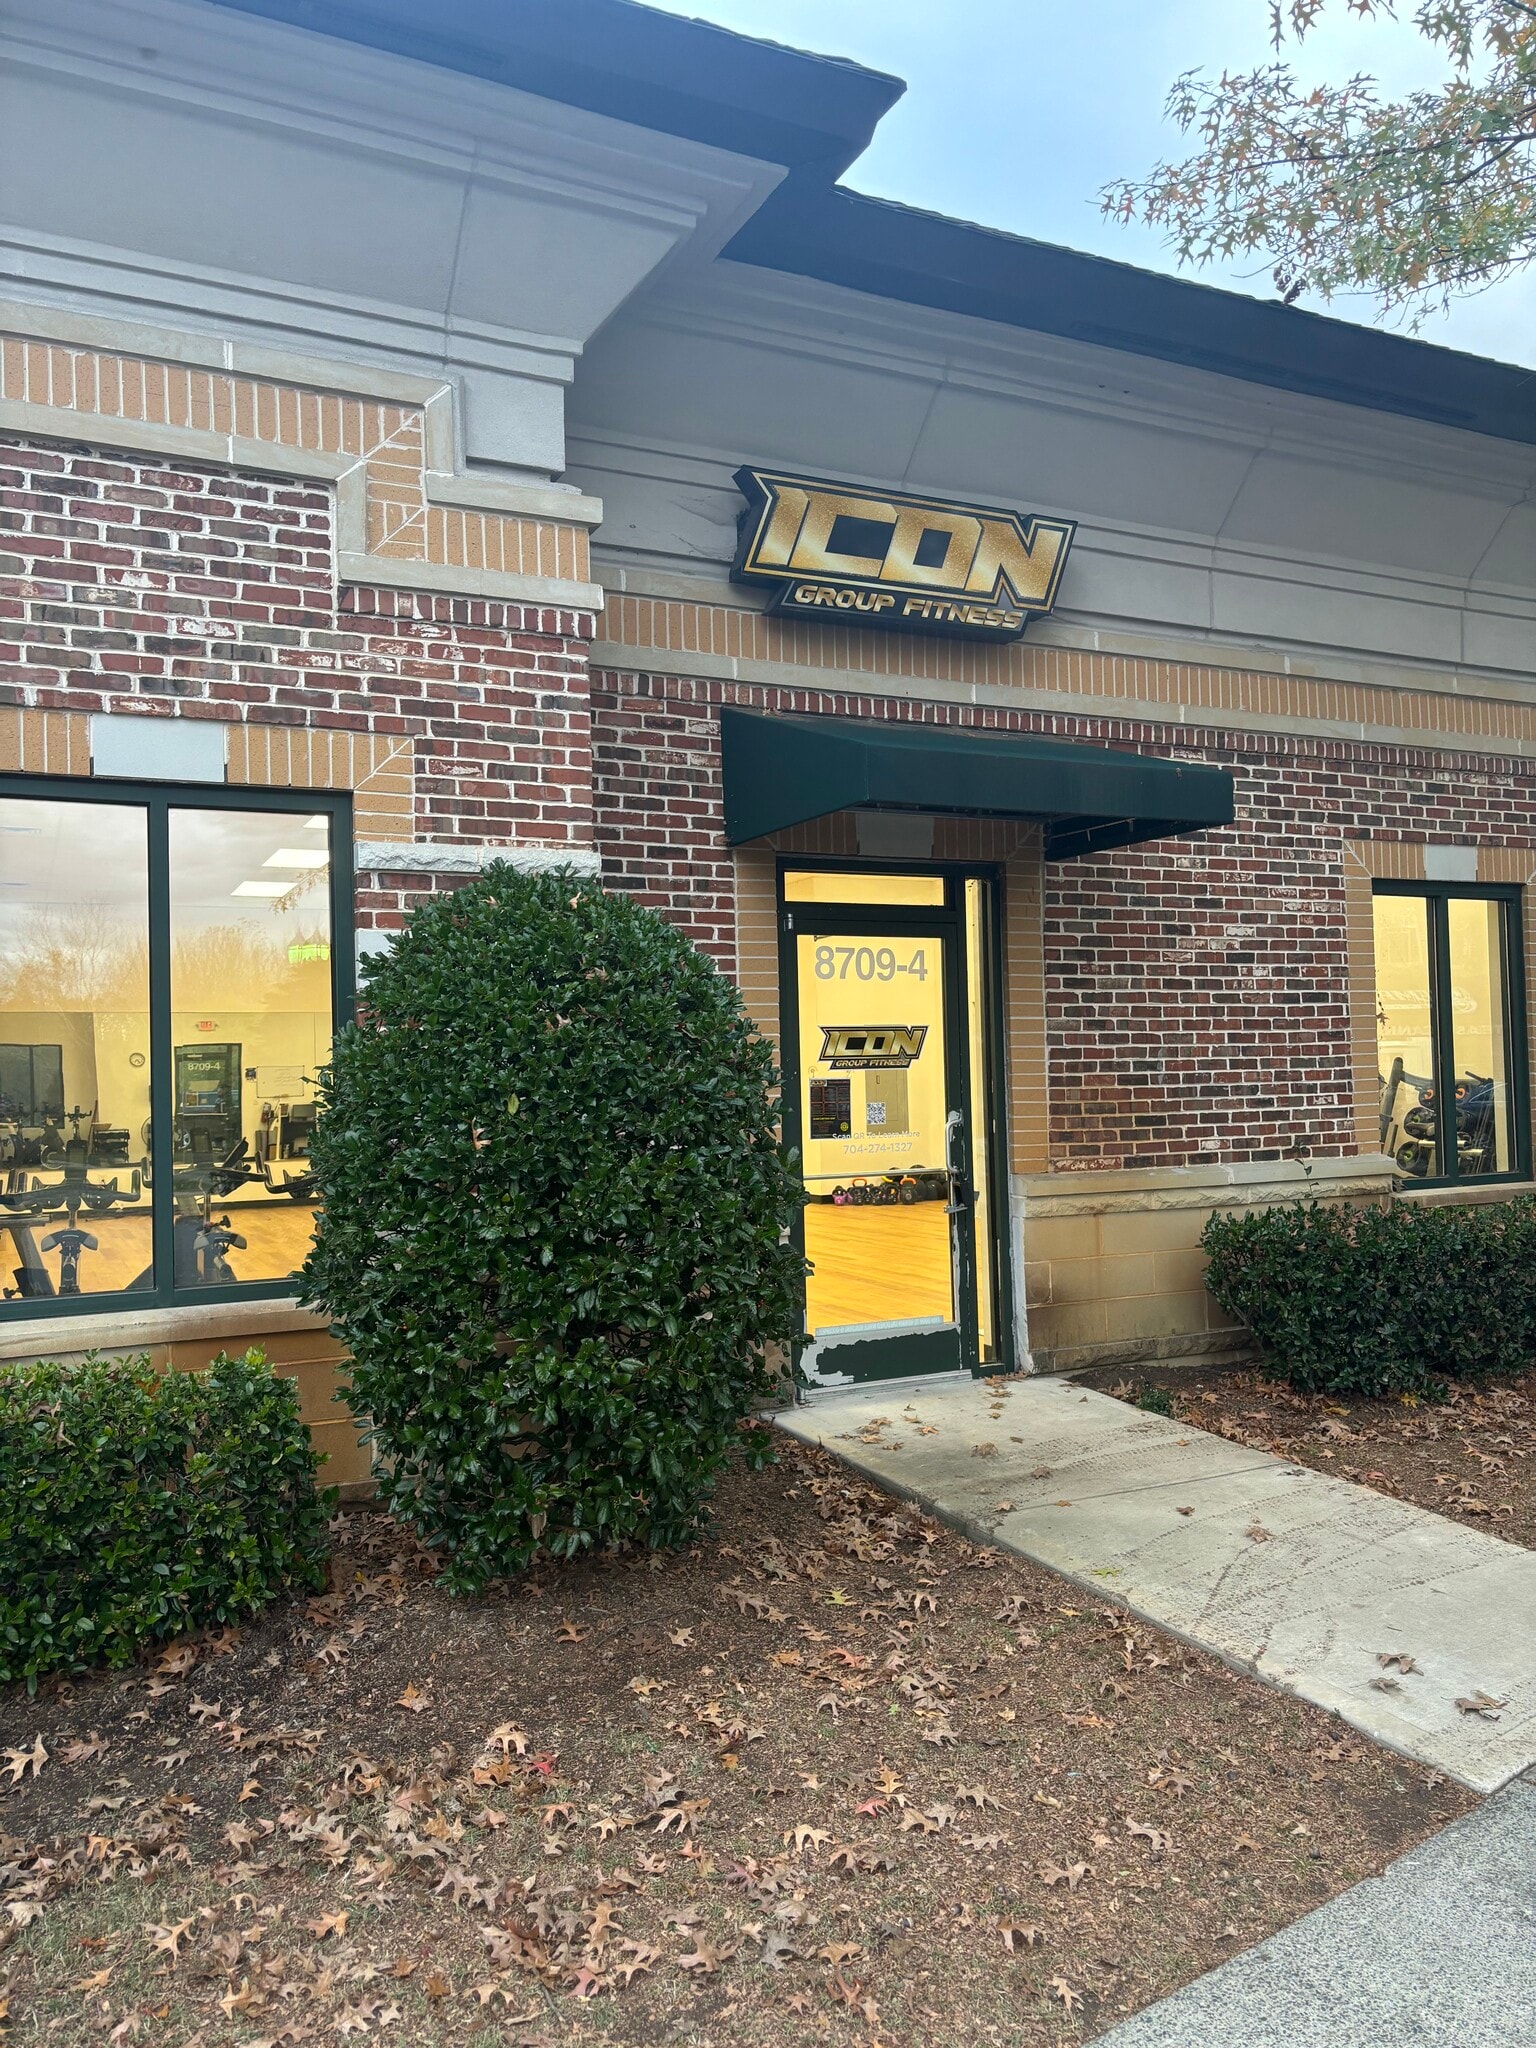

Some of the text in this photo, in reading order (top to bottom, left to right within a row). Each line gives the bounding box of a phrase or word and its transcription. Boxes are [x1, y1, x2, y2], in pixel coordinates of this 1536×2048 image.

[756, 484, 1064, 600] ICON
[793, 585, 1027, 630] GROUP FITNESS
[815, 945, 928, 981] 8709-4
[824, 1030, 923, 1056] ICON
[187, 1062, 220, 1070] 8709-4
[853, 1132, 865, 1140] QR
[867, 1131, 876, 1139] To
[878, 1131, 900, 1139] Learn
[901, 1130, 921, 1138] More
[843, 1142, 913, 1155] 704-274-1327
